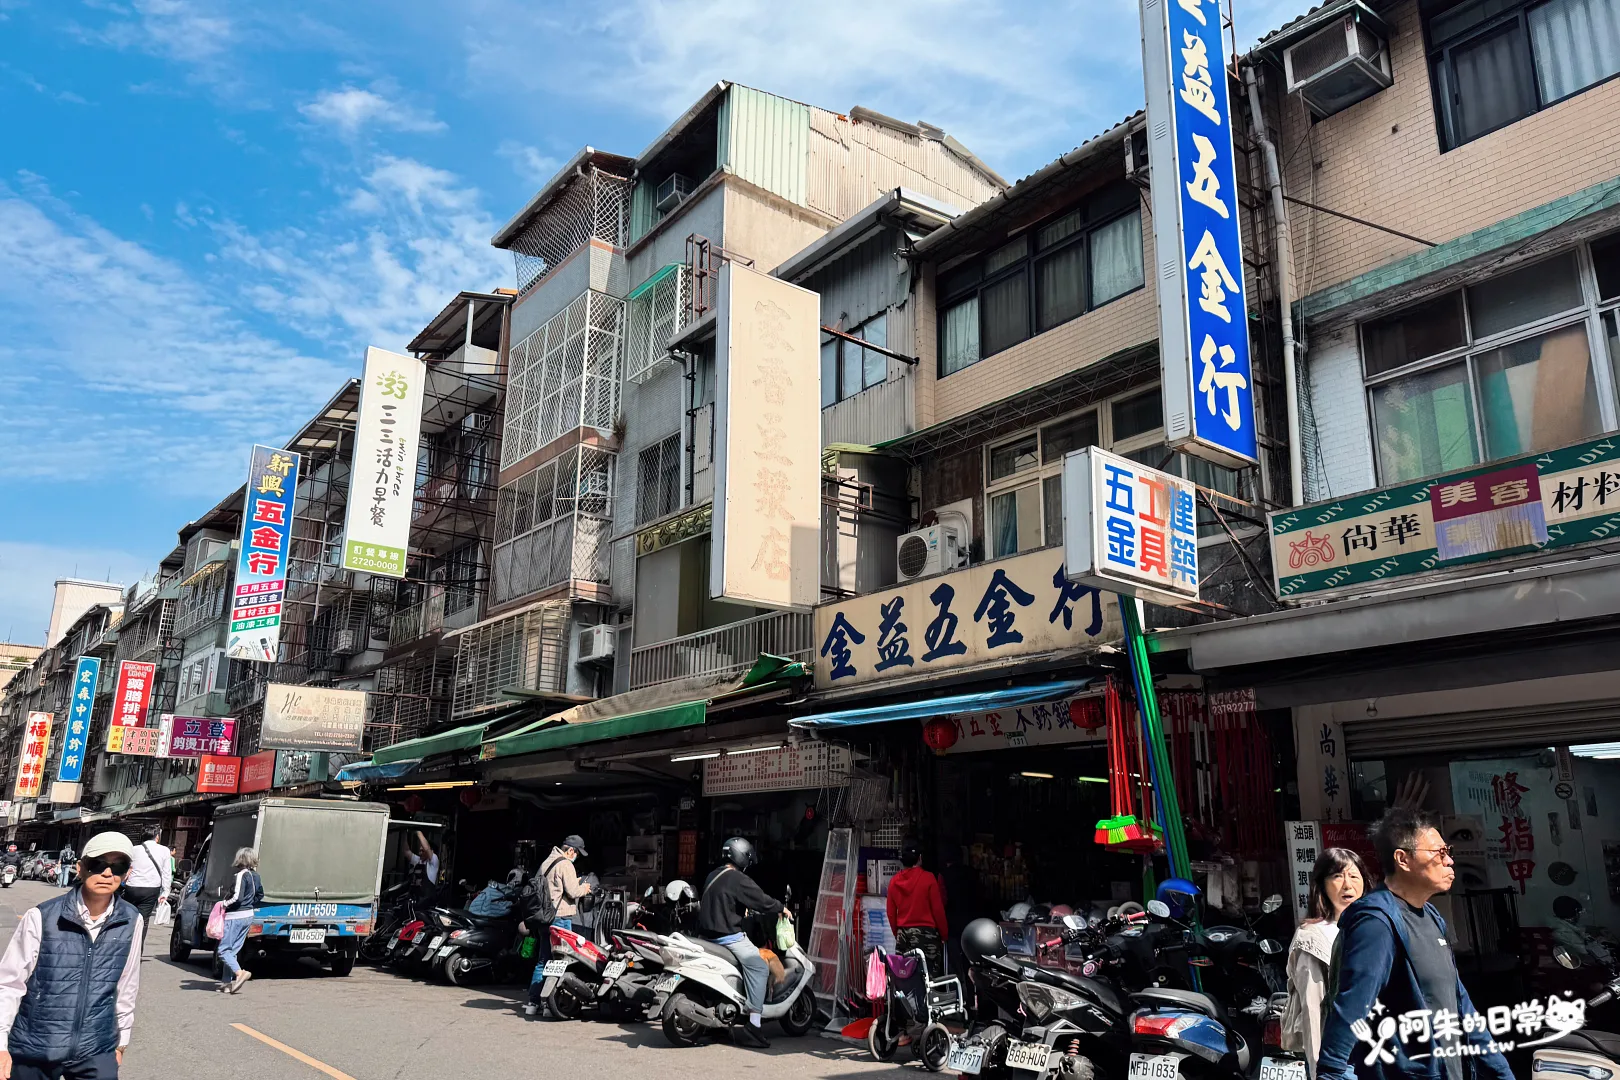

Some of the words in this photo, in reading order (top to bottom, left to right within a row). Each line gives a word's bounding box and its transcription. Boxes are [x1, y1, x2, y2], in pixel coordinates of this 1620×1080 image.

[1577, 440, 1616, 464] DIY
[369, 404, 397, 528] 三三活力早餐
[1362, 491, 1393, 513] DIY
[1439, 478, 1529, 508] 美容
[1104, 464, 1137, 568] 五金
[1273, 513, 1300, 534] DIY
[1316, 503, 1345, 524] DIY
[1138, 477, 1168, 578] 工具
[1169, 487, 1197, 586] 建築
[1341, 514, 1421, 556] 尚華
[352, 556, 398, 571] 2720-0009
[353, 545, 399, 561] 訂餐專線
[1324, 566, 1352, 587] DIY
[1370, 556, 1400, 578] DIY
[241, 582, 279, 593] 日用五金
[1280, 575, 1307, 595] DIY
[238, 594, 278, 605] 家庭五金
[237, 606, 277, 618] 建材五金
[820, 563, 1106, 681] 金益五金行
[236, 617, 275, 630] 油漆工程
[65, 668, 94, 769] 宏森中醫診所
[1212, 701, 1254, 715] 23782277
[183, 720, 226, 738] 立登
[26, 721, 48, 759] 福順
[173, 737, 232, 752] 剪燙工作室
[216, 764, 236, 774] 蝦皮
[1320, 723, 1339, 801] 尚華
[203, 773, 235, 784] 店到店
[1294, 825, 1314, 840] 油頭
[1491, 772, 1535, 895] 修指甲
[1130, 1060, 1175, 1079] NFB-1833
